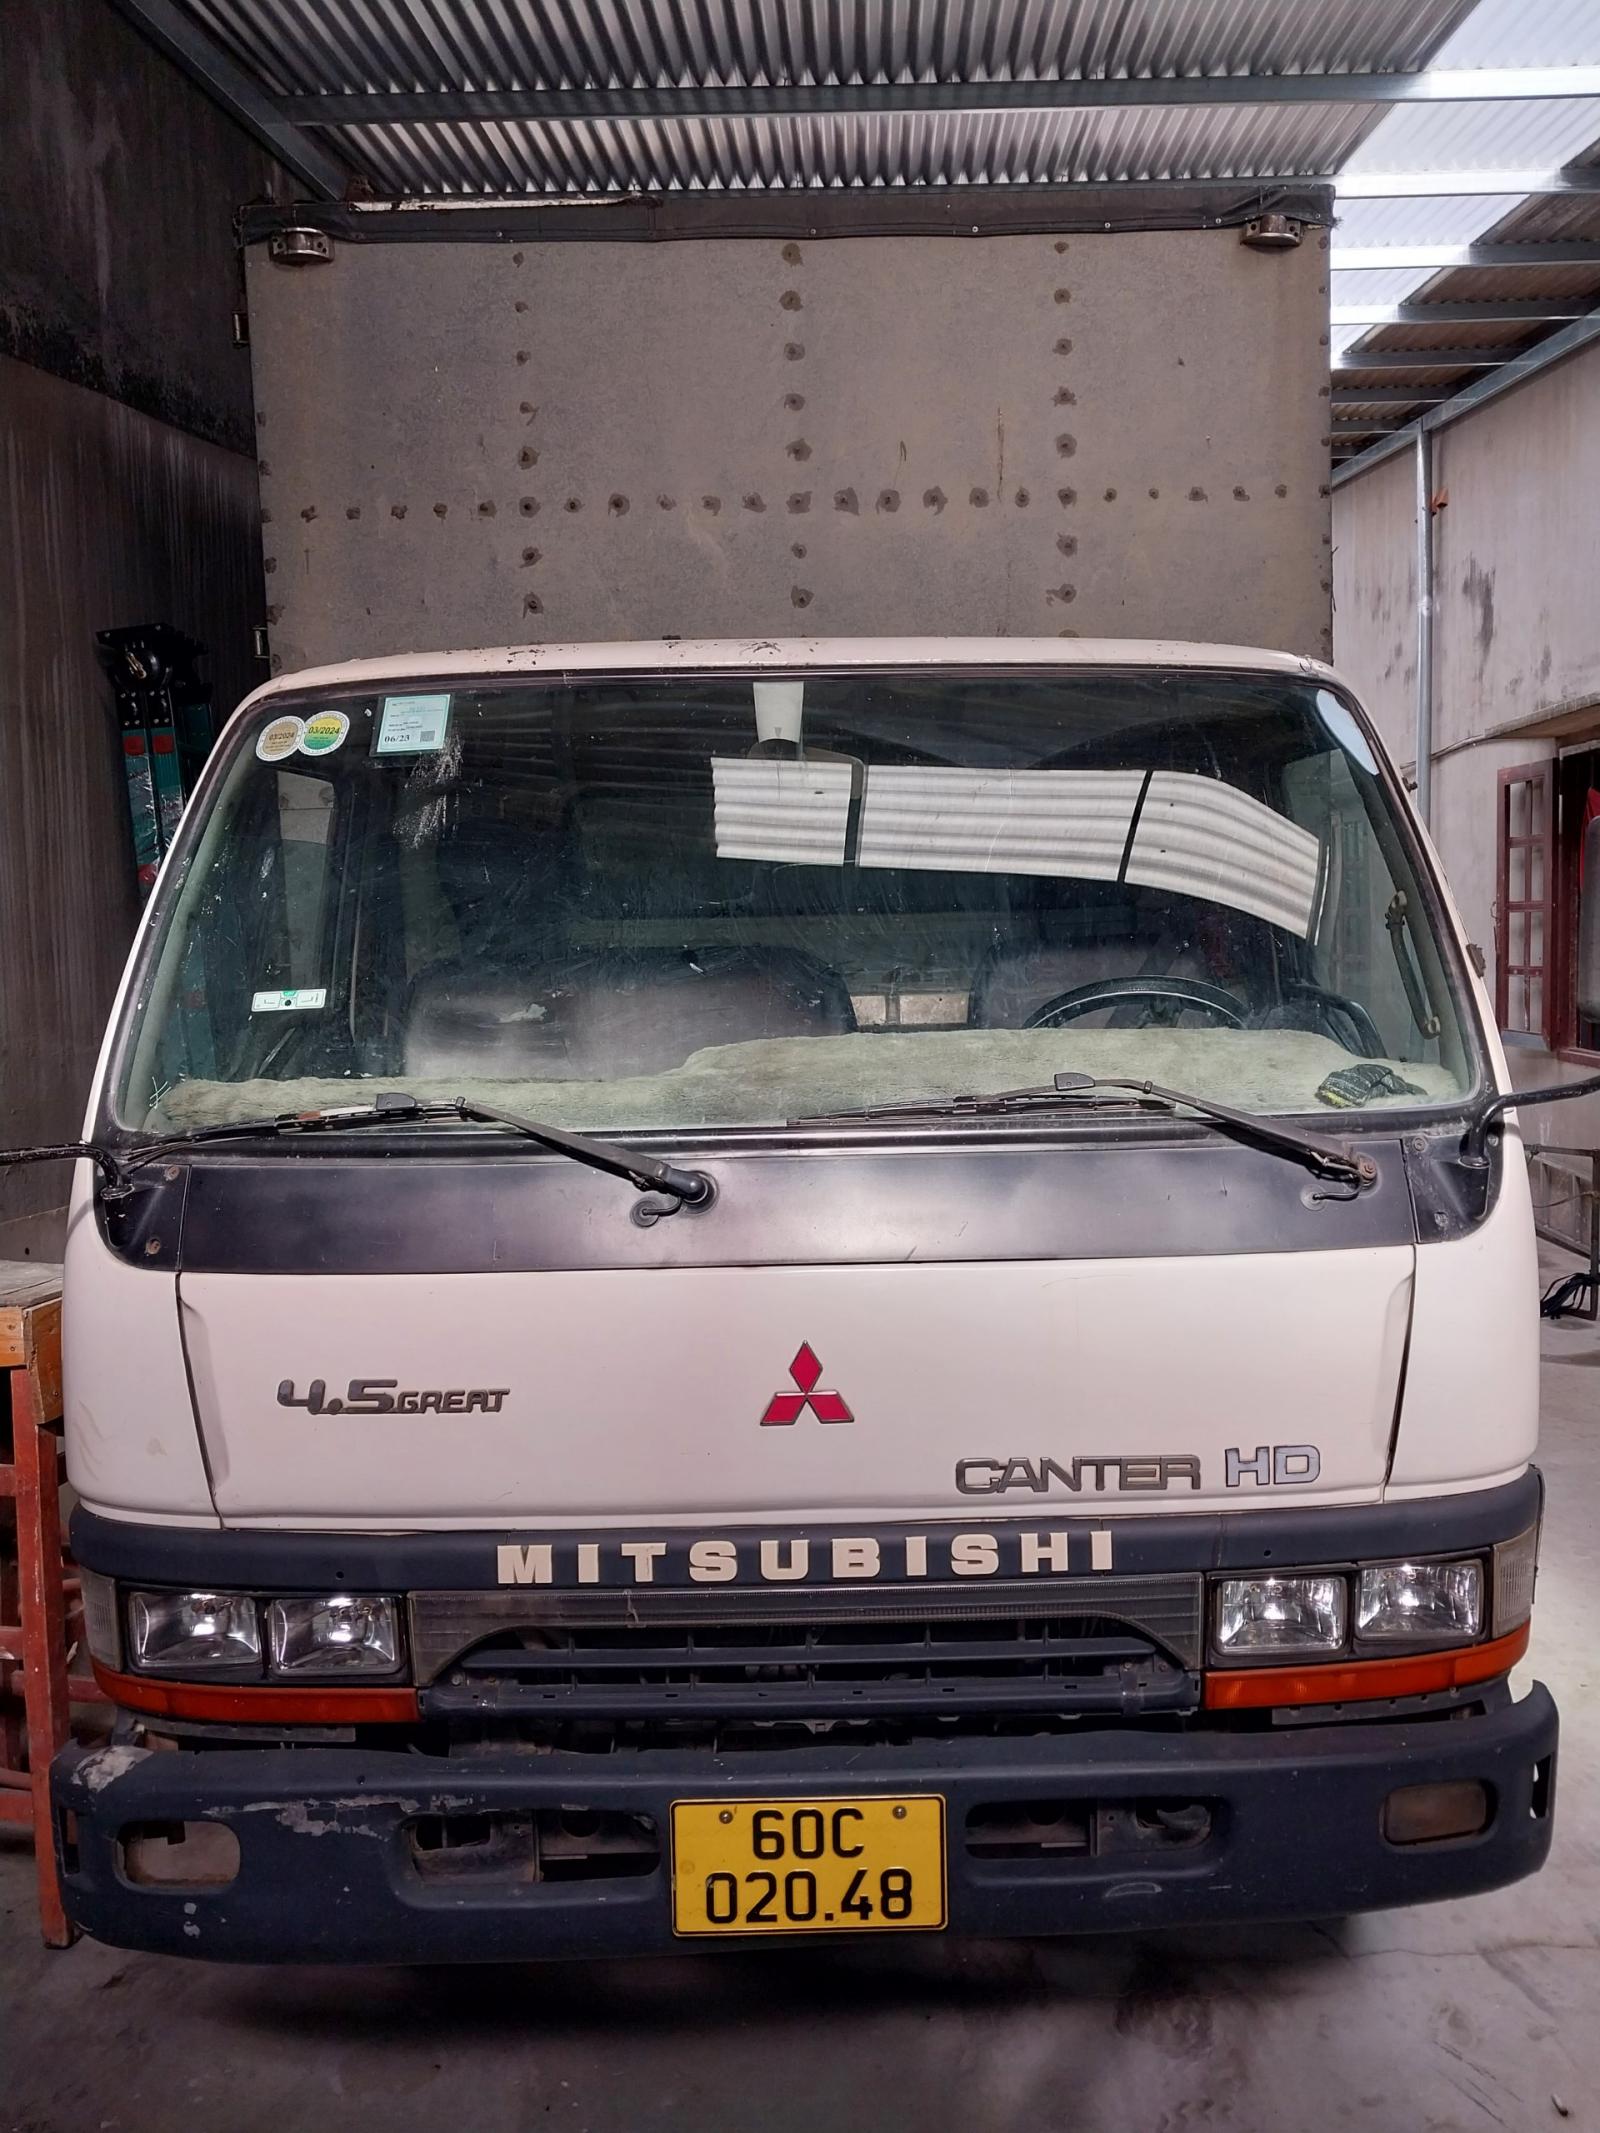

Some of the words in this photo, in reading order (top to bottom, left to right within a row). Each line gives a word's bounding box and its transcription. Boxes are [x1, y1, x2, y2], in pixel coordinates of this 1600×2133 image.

[308, 726, 340, 735] 03/2024
[384, 734, 410, 743] 06/23
[398, 1388, 511, 1414] GREAT
[955, 1454, 1202, 1494] CANTER
[1224, 1444, 1321, 1488] HD
[496, 1530, 1114, 1585] MITSUBISHI
[752, 1807, 865, 1861] 60C
[705, 1866, 913, 1925] 020.48
